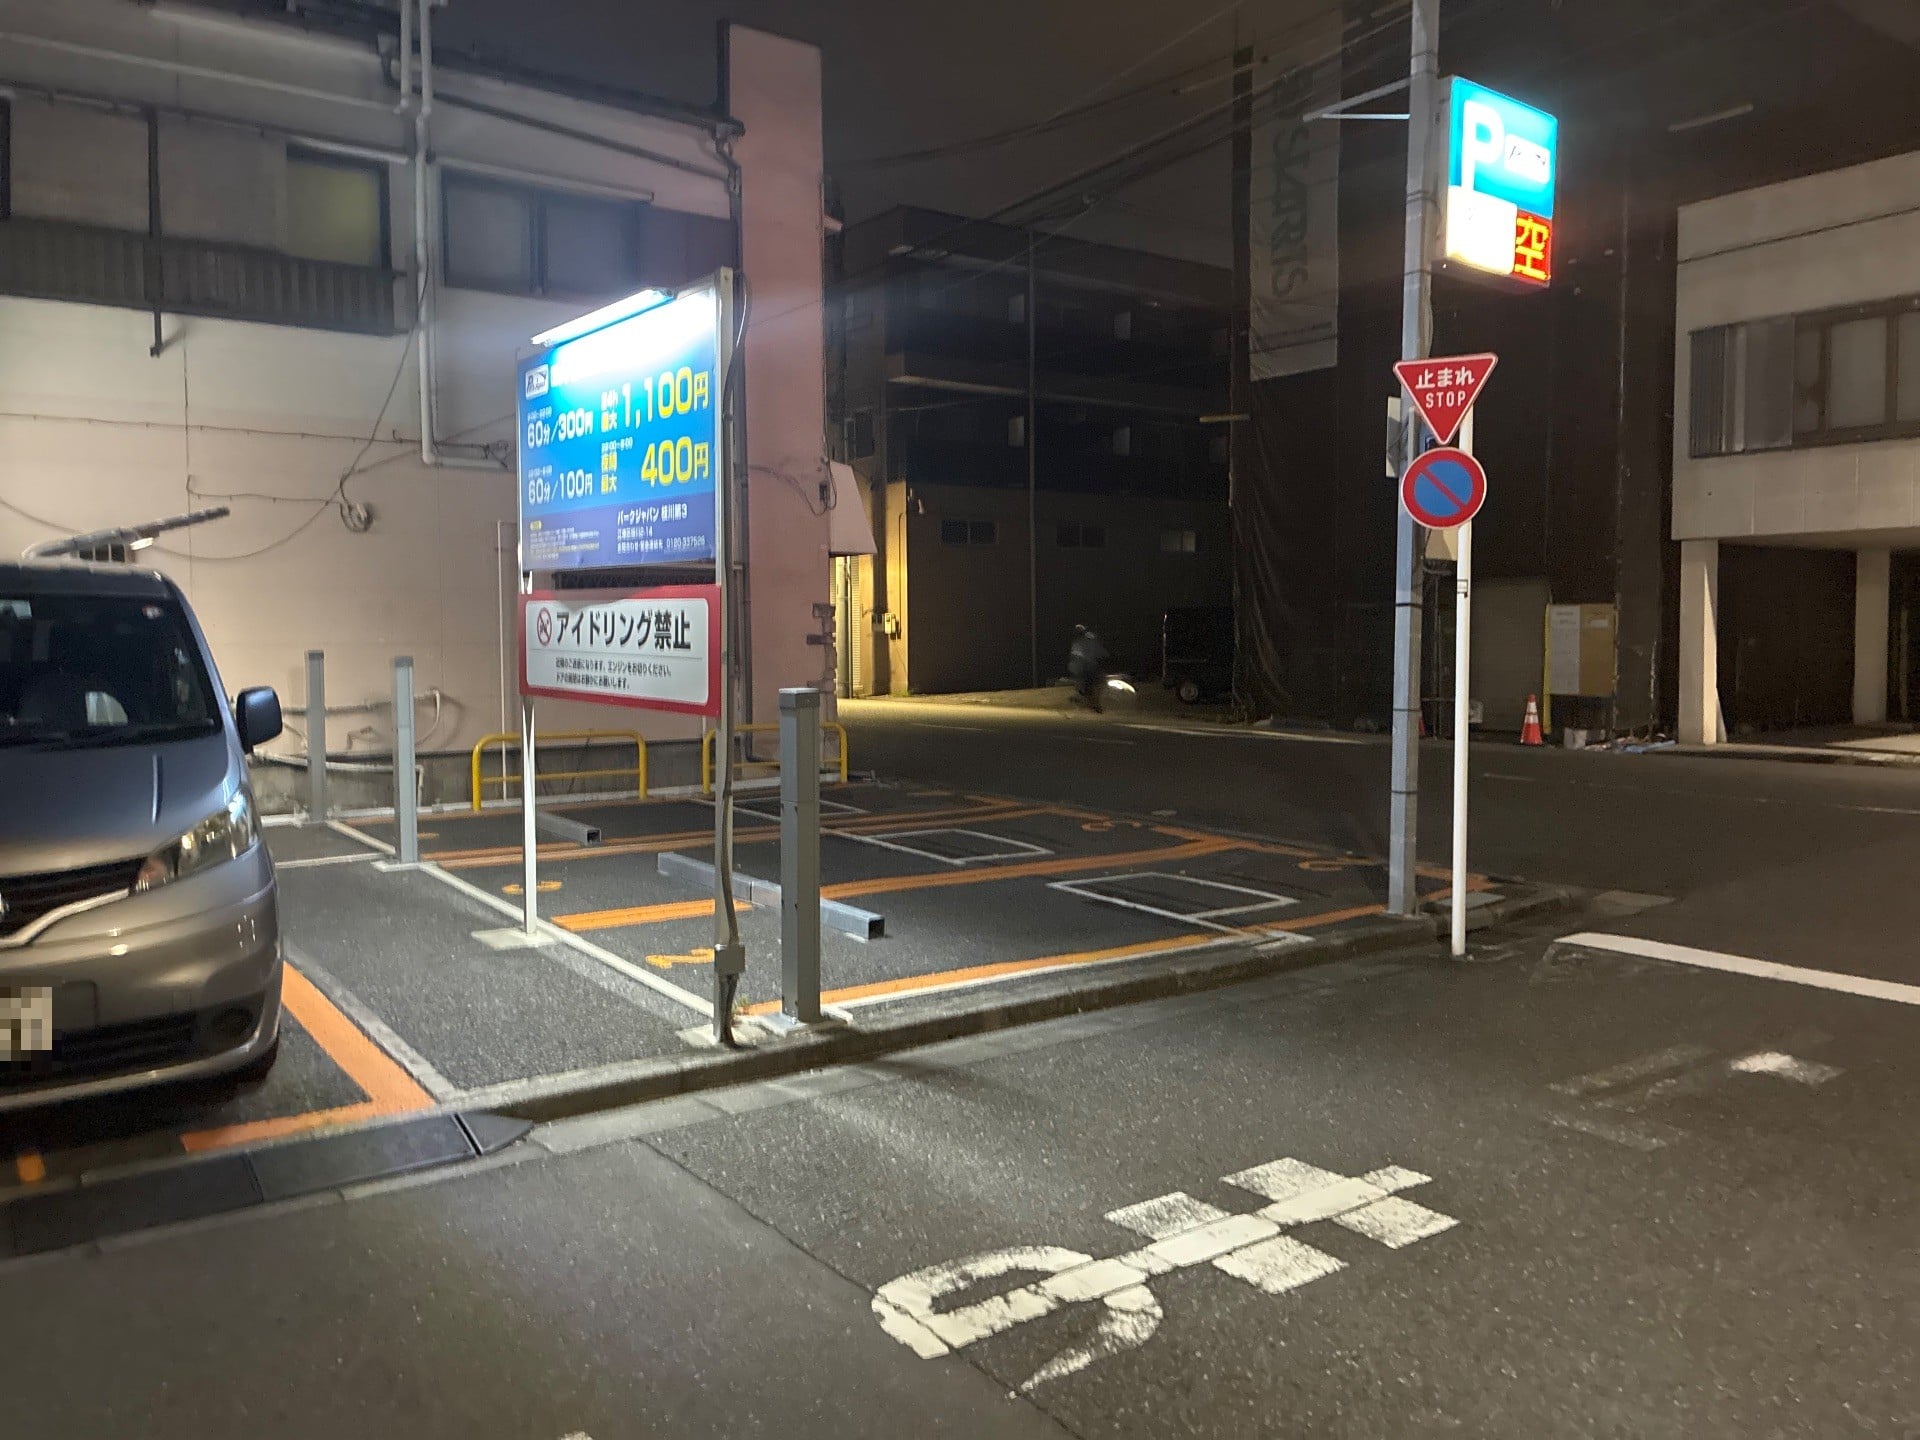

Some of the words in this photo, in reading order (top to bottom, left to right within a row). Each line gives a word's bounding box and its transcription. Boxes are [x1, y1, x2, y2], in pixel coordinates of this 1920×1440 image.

[1461, 99, 1505, 191] P
[1515, 214, 1550, 281] 空
[621, 366, 709, 430] 1,100円
[1415, 366, 1475, 390] 止まれ
[1425, 390, 1466, 409] STOP
[641, 436, 709, 487] 400円
[556, 609, 691, 650] アイドリング禁止
